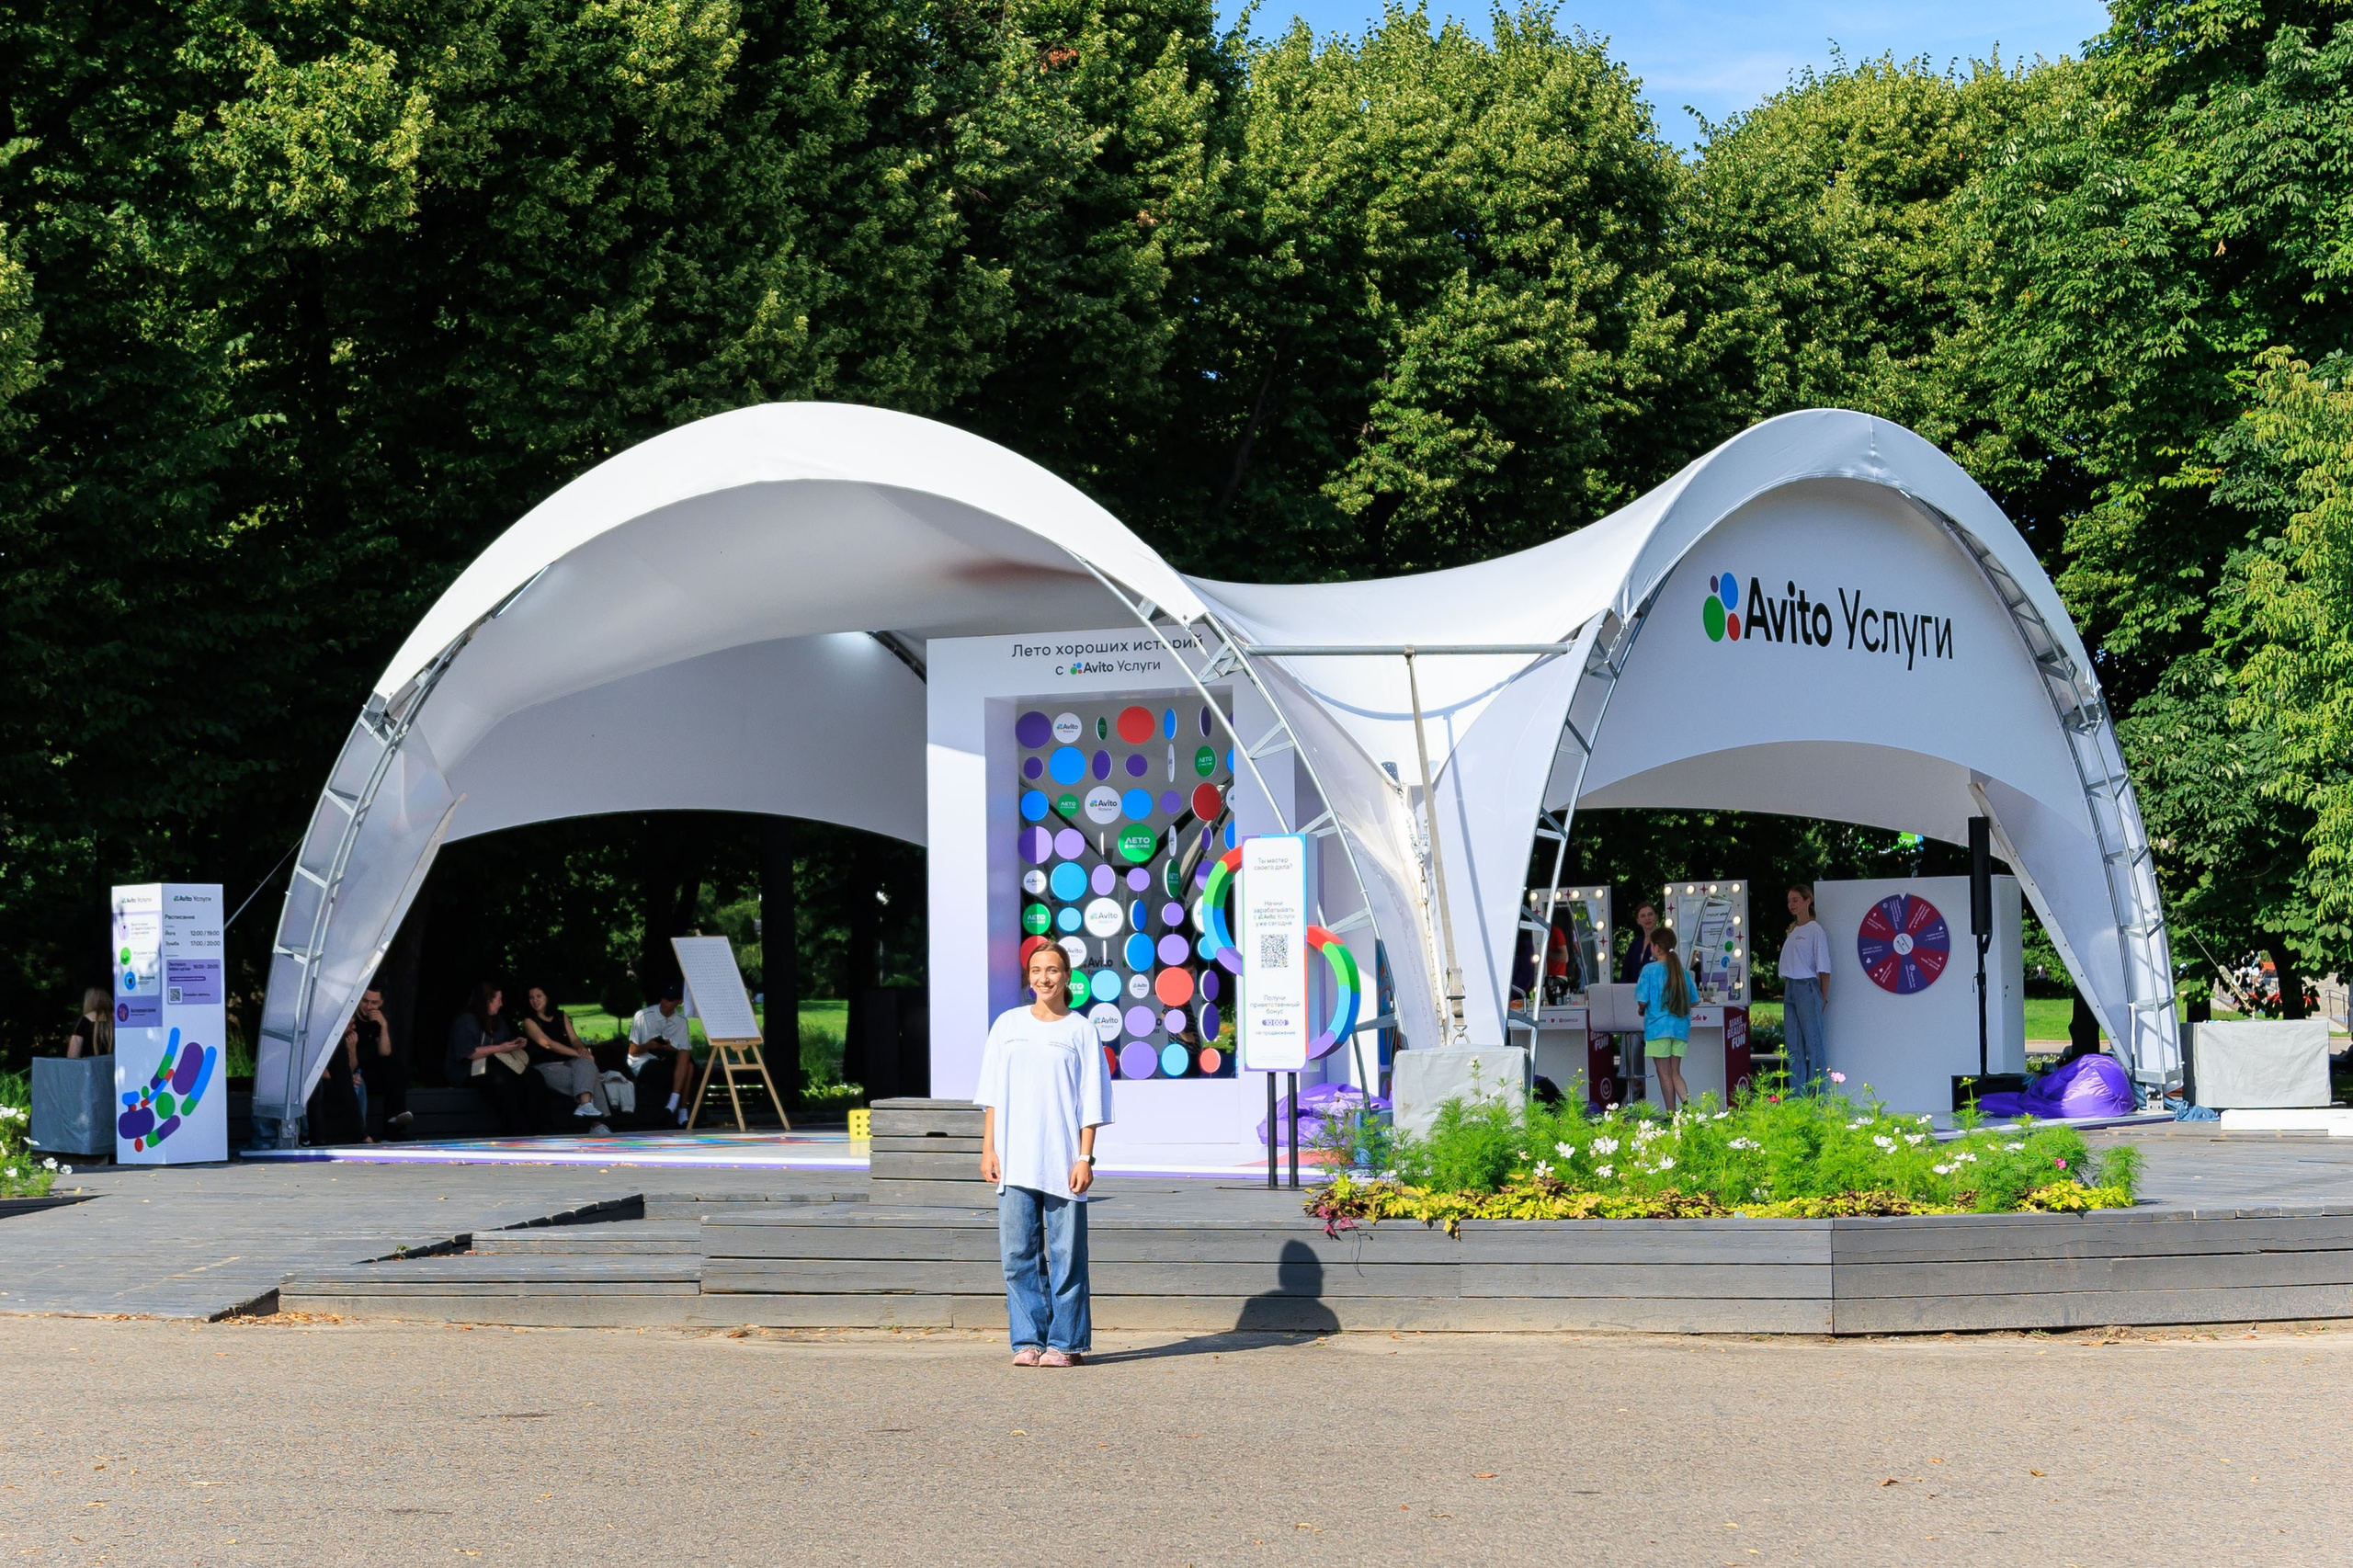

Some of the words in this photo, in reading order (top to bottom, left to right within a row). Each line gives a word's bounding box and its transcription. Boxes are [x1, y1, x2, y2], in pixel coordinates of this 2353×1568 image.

[1744, 576, 1833, 648] Avito
[1837, 586, 1953, 671] Услуги
[1012, 644, 1051, 657] Лето
[1055, 642, 1129, 658] хороших
[1055, 665, 1064, 676] с
[1083, 662, 1114, 674] Avito
[1117, 660, 1161, 674] Услуги
[1729, 1015, 1743, 1028] MAKE
[1727, 1022, 1747, 1040] BEAUTY
[1595, 1035, 1609, 1051] FUN
[1732, 1032, 1745, 1050] FUN
